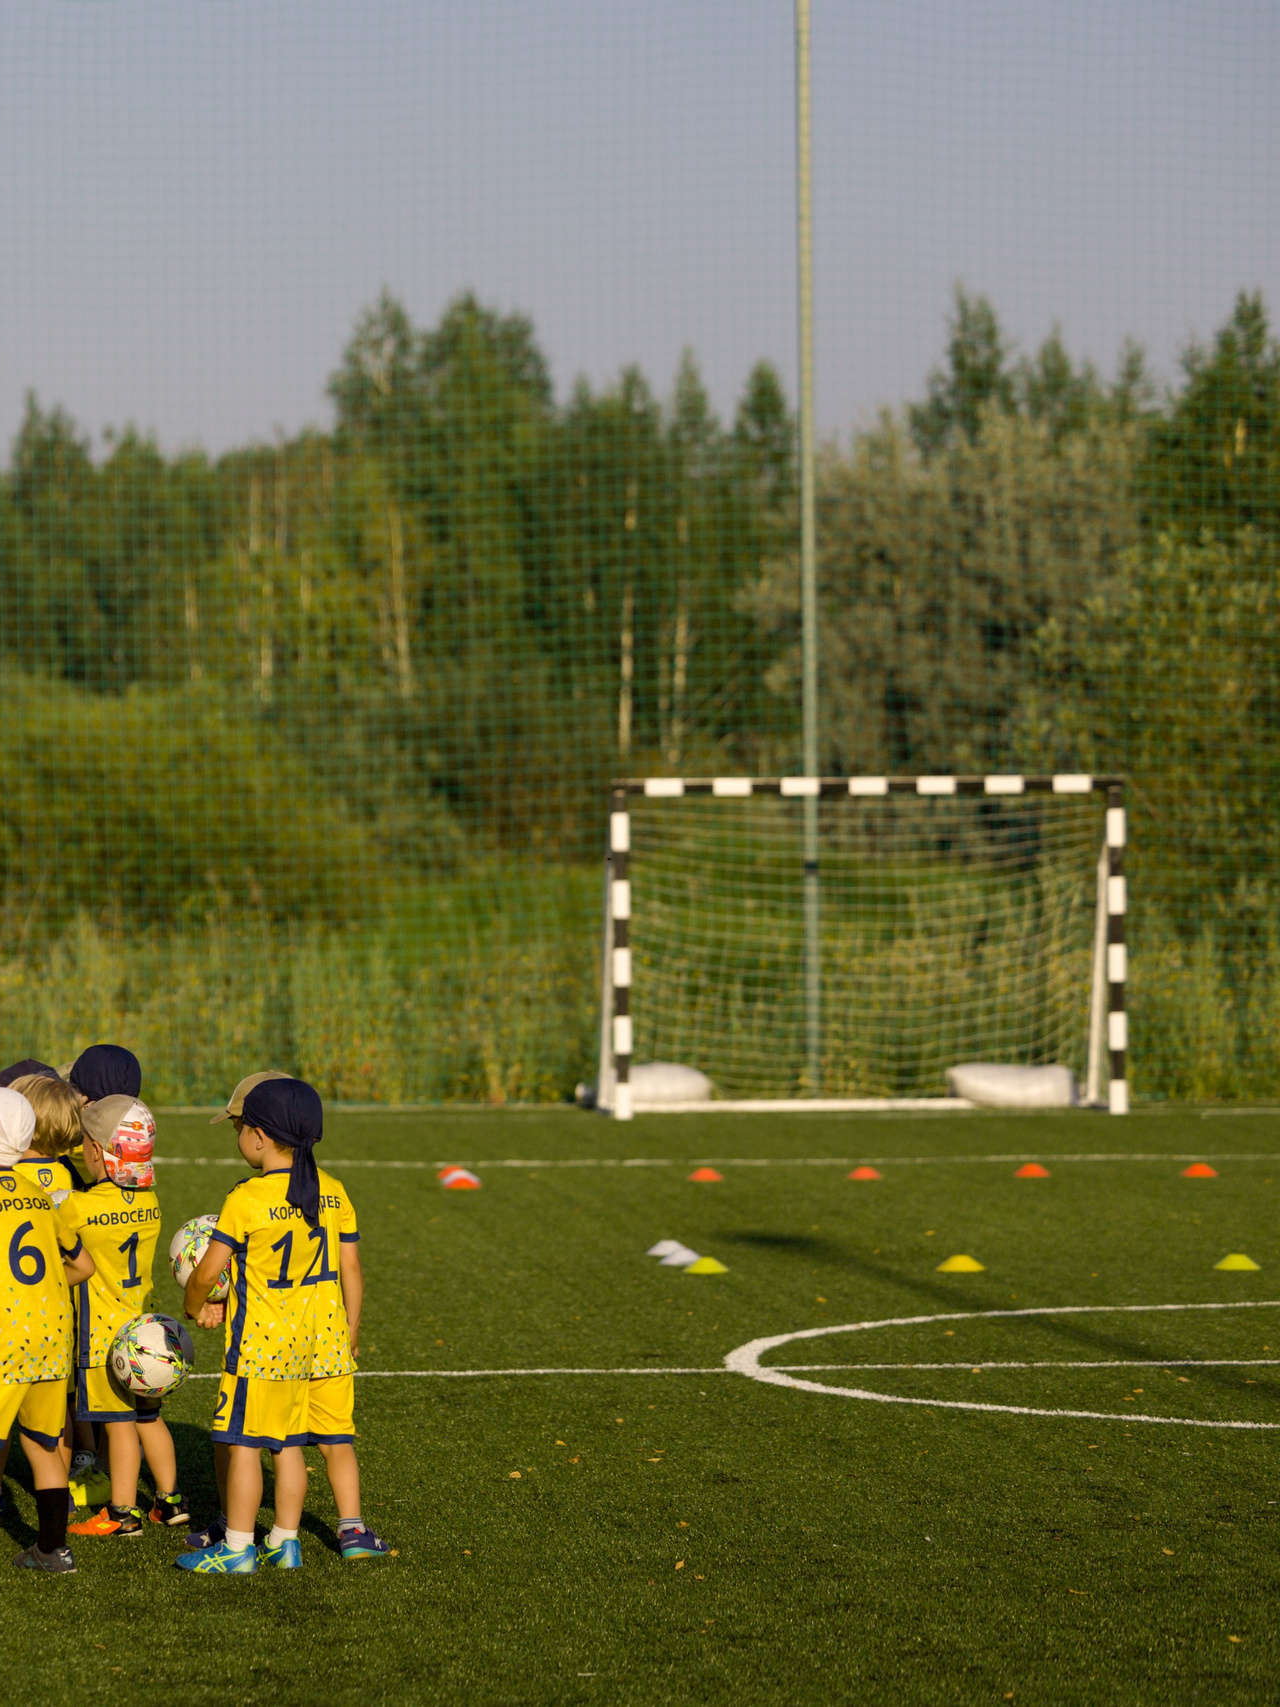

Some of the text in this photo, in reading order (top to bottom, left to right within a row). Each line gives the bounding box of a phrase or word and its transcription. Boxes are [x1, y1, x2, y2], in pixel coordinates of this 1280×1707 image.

[87, 1207, 162, 1226] НОВОСЁЛО
[8, 1220, 46, 1286] 6
[118, 1232, 142, 1289] 1
